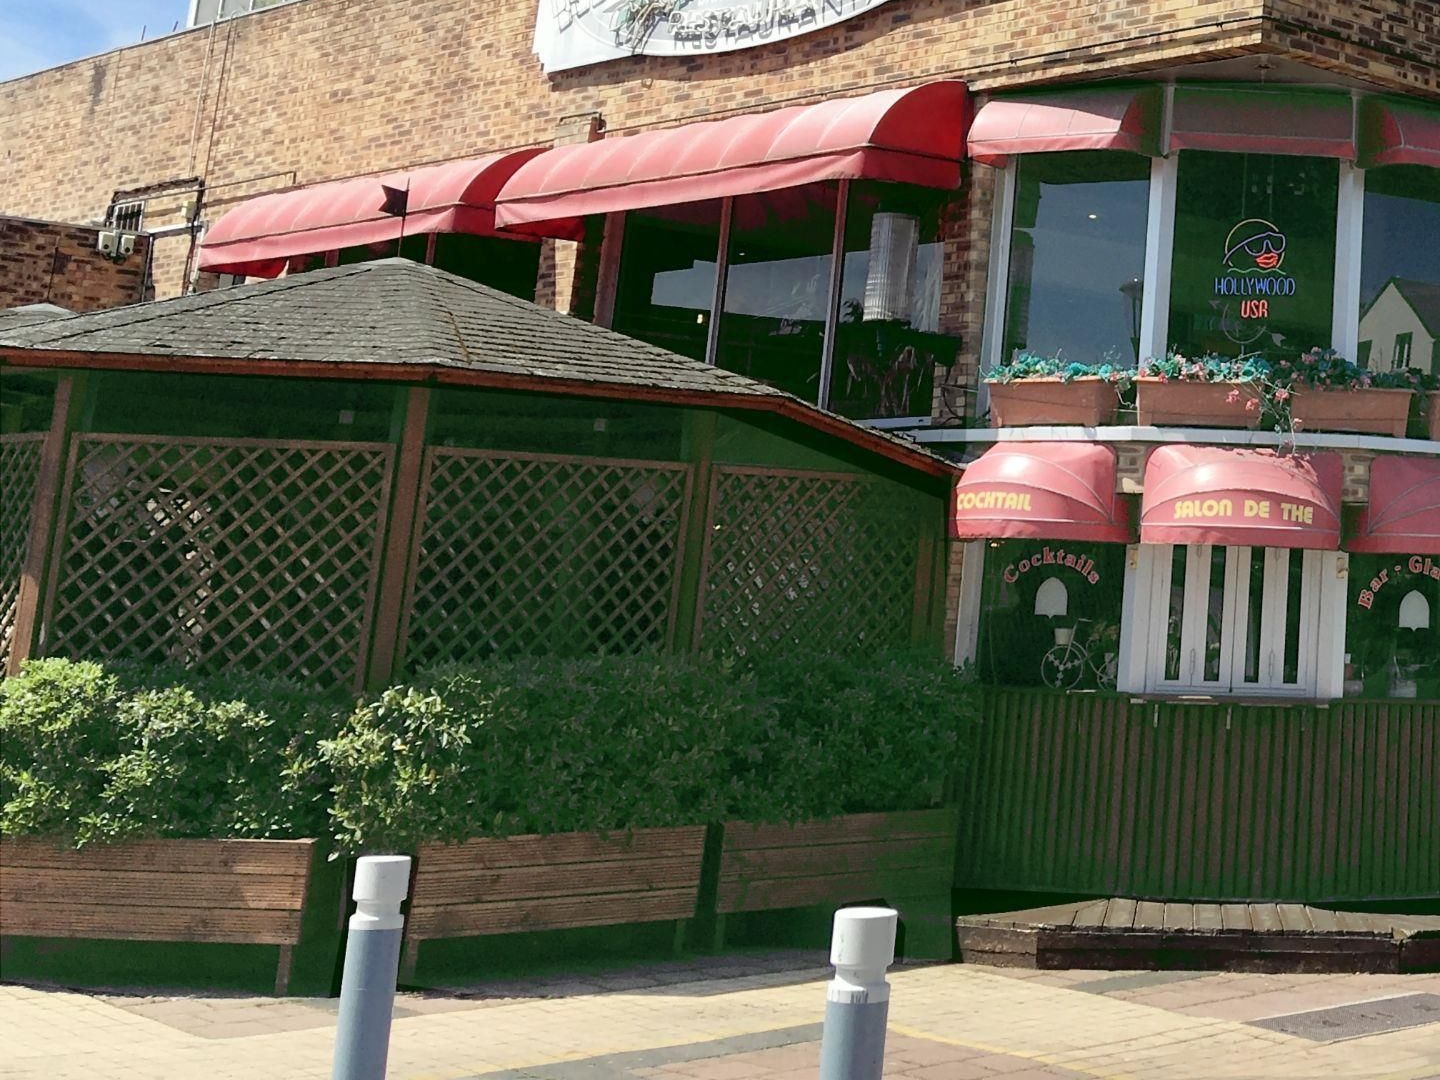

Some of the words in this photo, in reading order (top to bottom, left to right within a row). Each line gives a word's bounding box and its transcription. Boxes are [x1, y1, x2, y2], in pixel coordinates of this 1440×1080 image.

[1214, 276, 1296, 296] HOLLYWOOD
[1241, 299, 1268, 318] USA
[956, 491, 1032, 511] COCKTAIL
[1174, 498, 1233, 519] SALON
[1243, 499, 1271, 519] DE
[1280, 502, 1314, 524] THE
[1003, 546, 1100, 585] Cocktails
[1357, 568, 1390, 610] Bar
